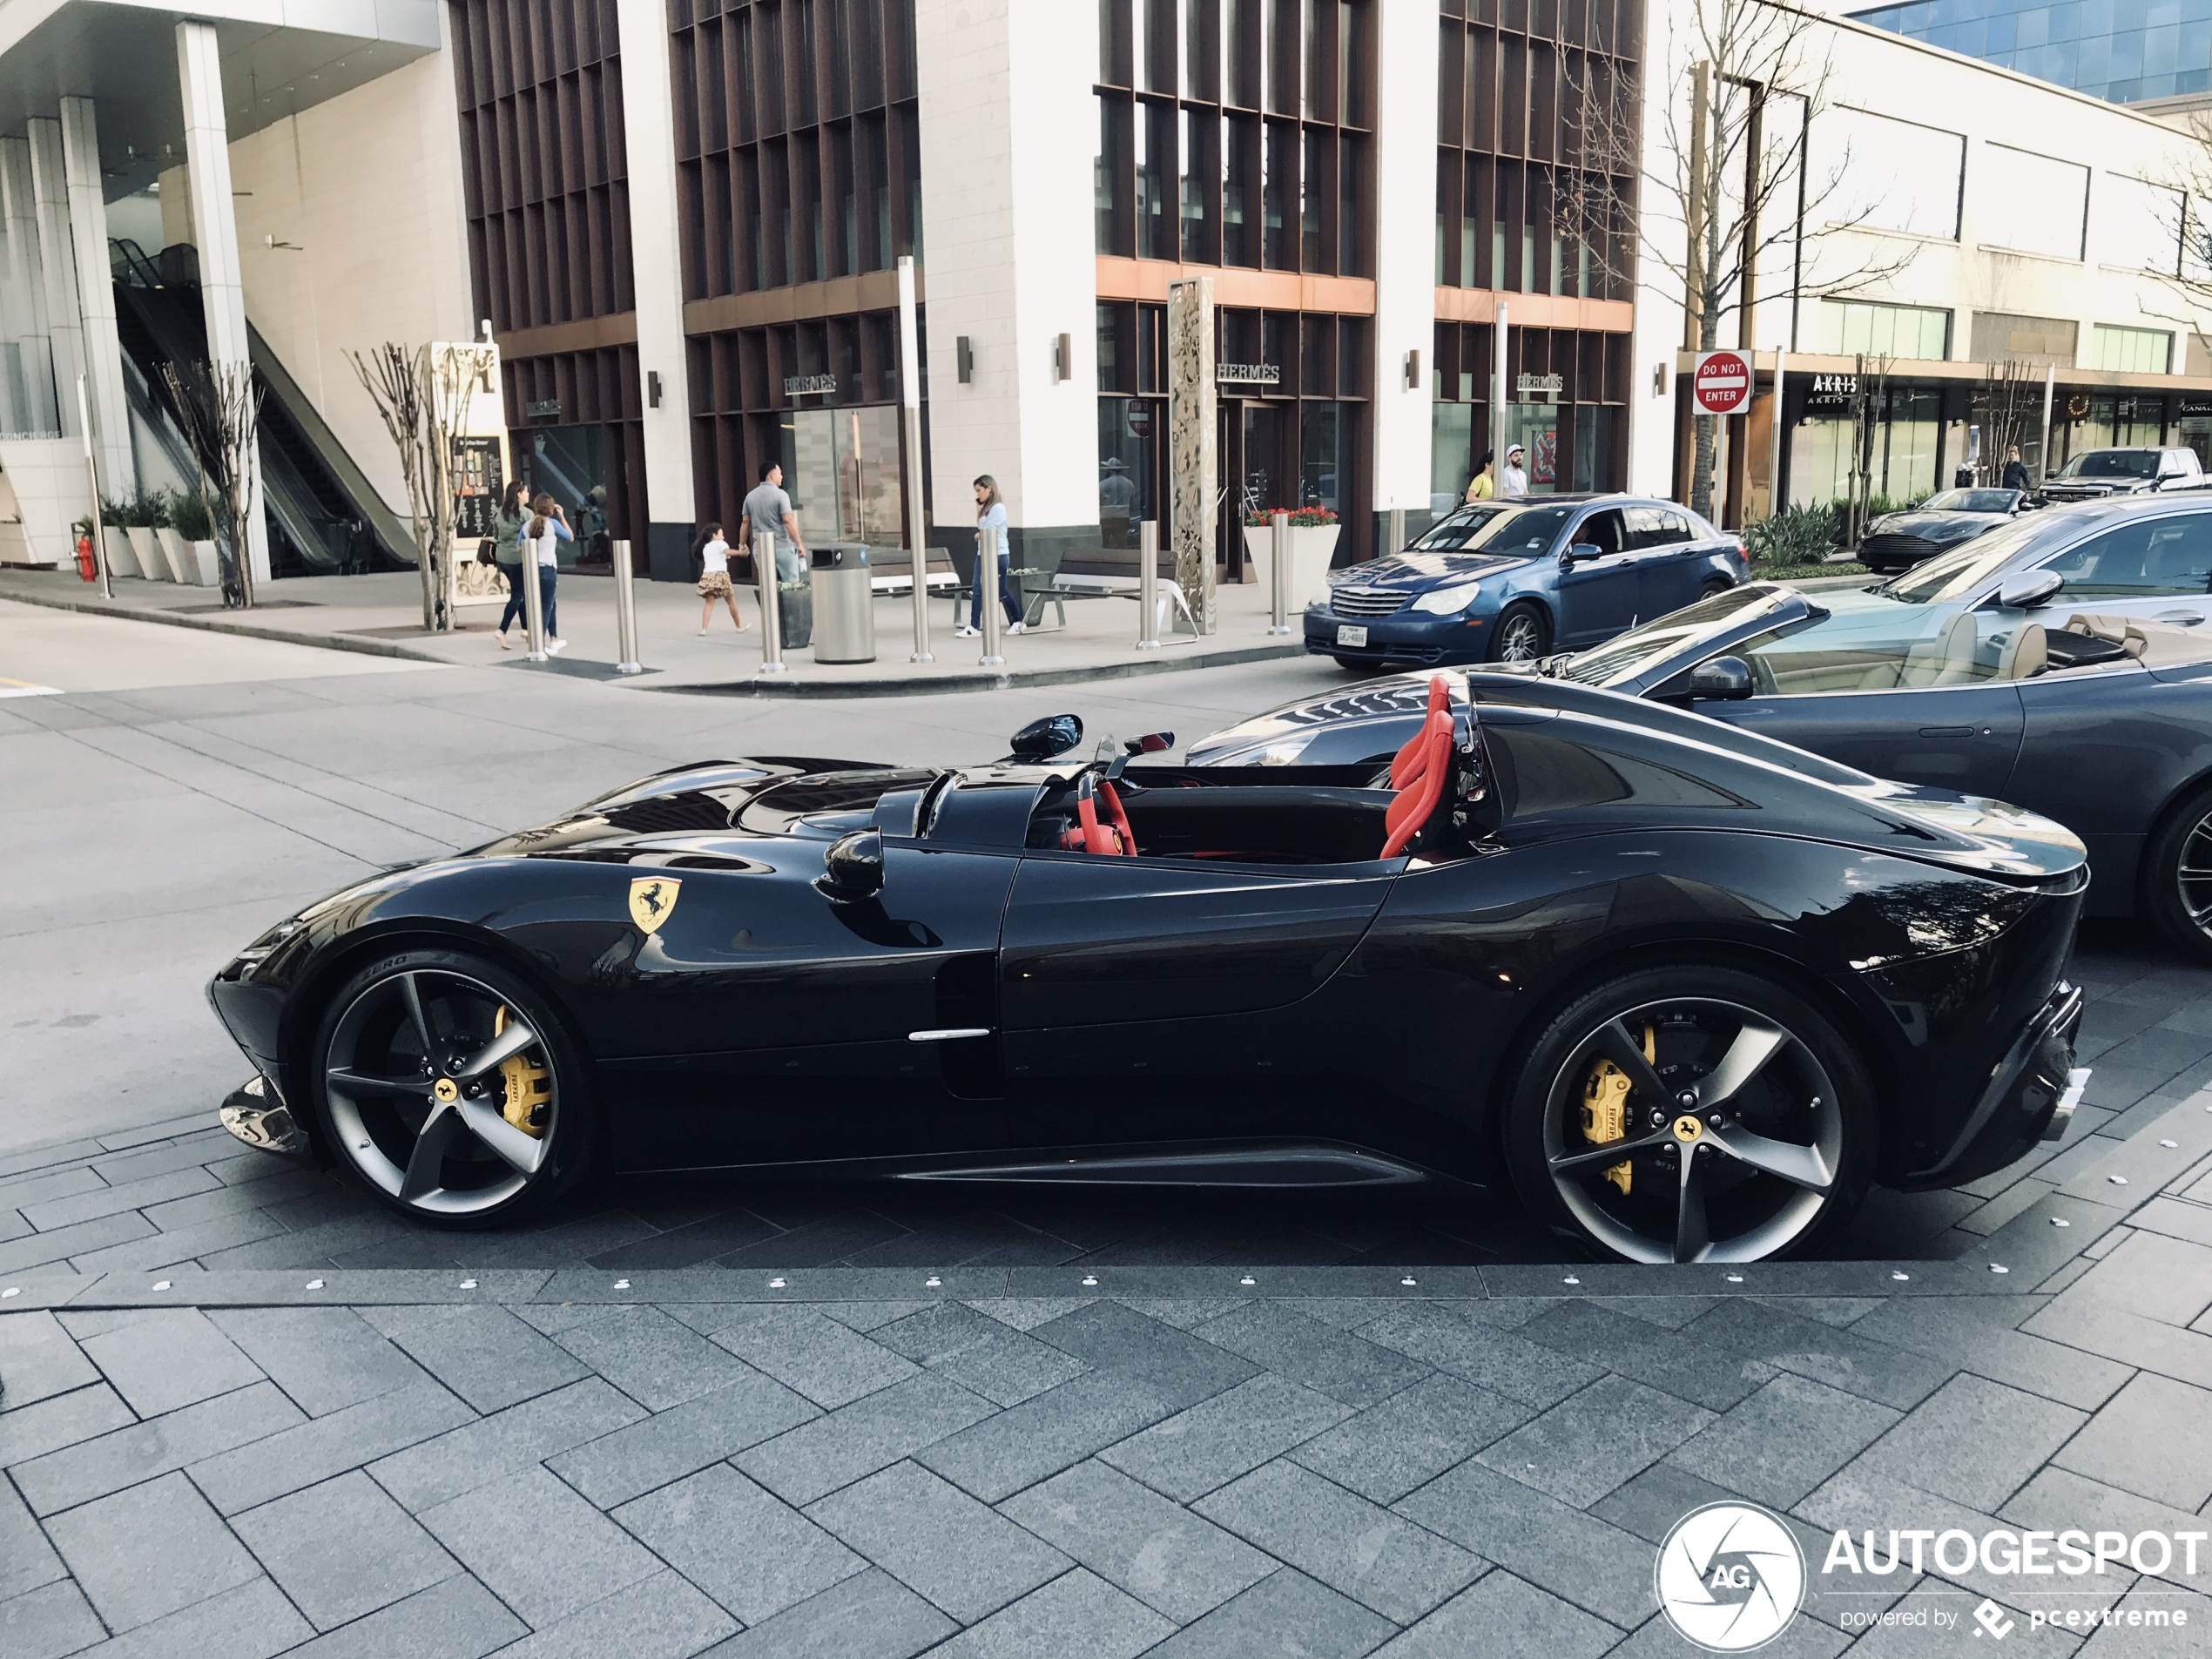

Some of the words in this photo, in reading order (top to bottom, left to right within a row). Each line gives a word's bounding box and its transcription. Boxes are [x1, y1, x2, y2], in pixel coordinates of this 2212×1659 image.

[1703, 365, 1717, 375] DO
[1721, 363, 1742, 374] NOT
[1705, 391, 1737, 401] ENTER
